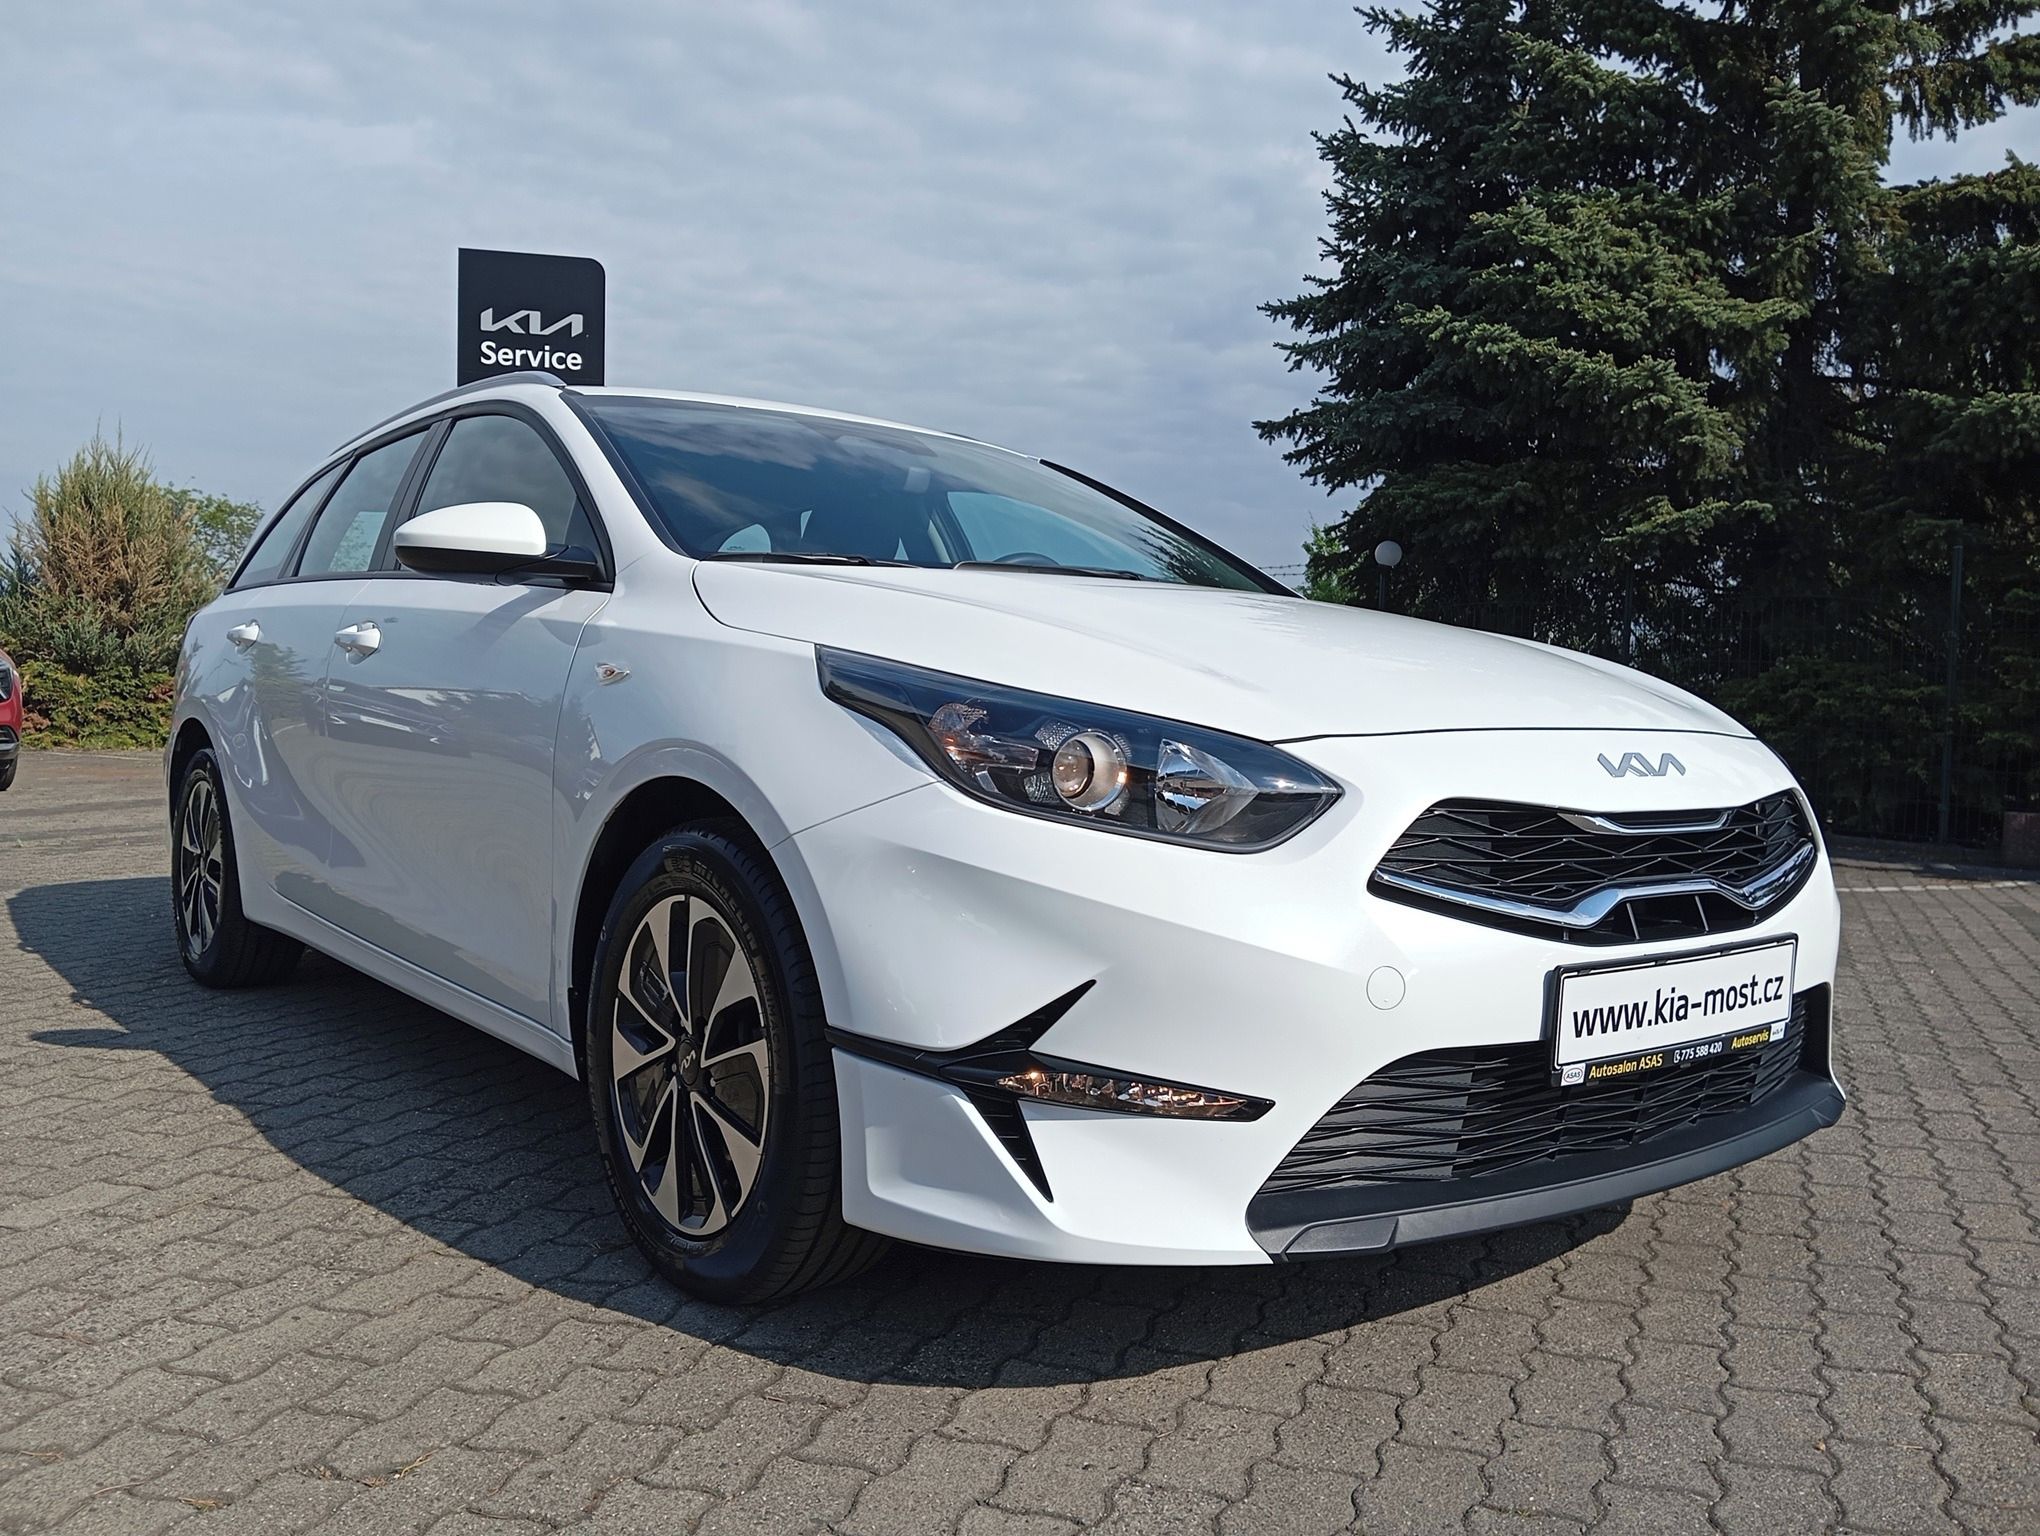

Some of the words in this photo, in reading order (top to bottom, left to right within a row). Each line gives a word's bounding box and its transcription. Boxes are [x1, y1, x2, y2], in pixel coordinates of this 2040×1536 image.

[480, 307, 584, 338] KIA
[480, 341, 583, 370] Service
[1597, 752, 1686, 777] KIA
[692, 860, 758, 952] MICHELIN
[1573, 974, 1784, 1038] www.kia-most.cz
[1681, 1047, 1695, 1061] 775
[1695, 1044, 1709, 1058] 588
[1709, 1041, 1723, 1054] 420
[1731, 1029, 1769, 1050] Autoservis
[1566, 1071, 1581, 1079] ASAS
[1589, 1061, 1637, 1079] Autosalon
[1639, 1053, 1663, 1071] ASAS
